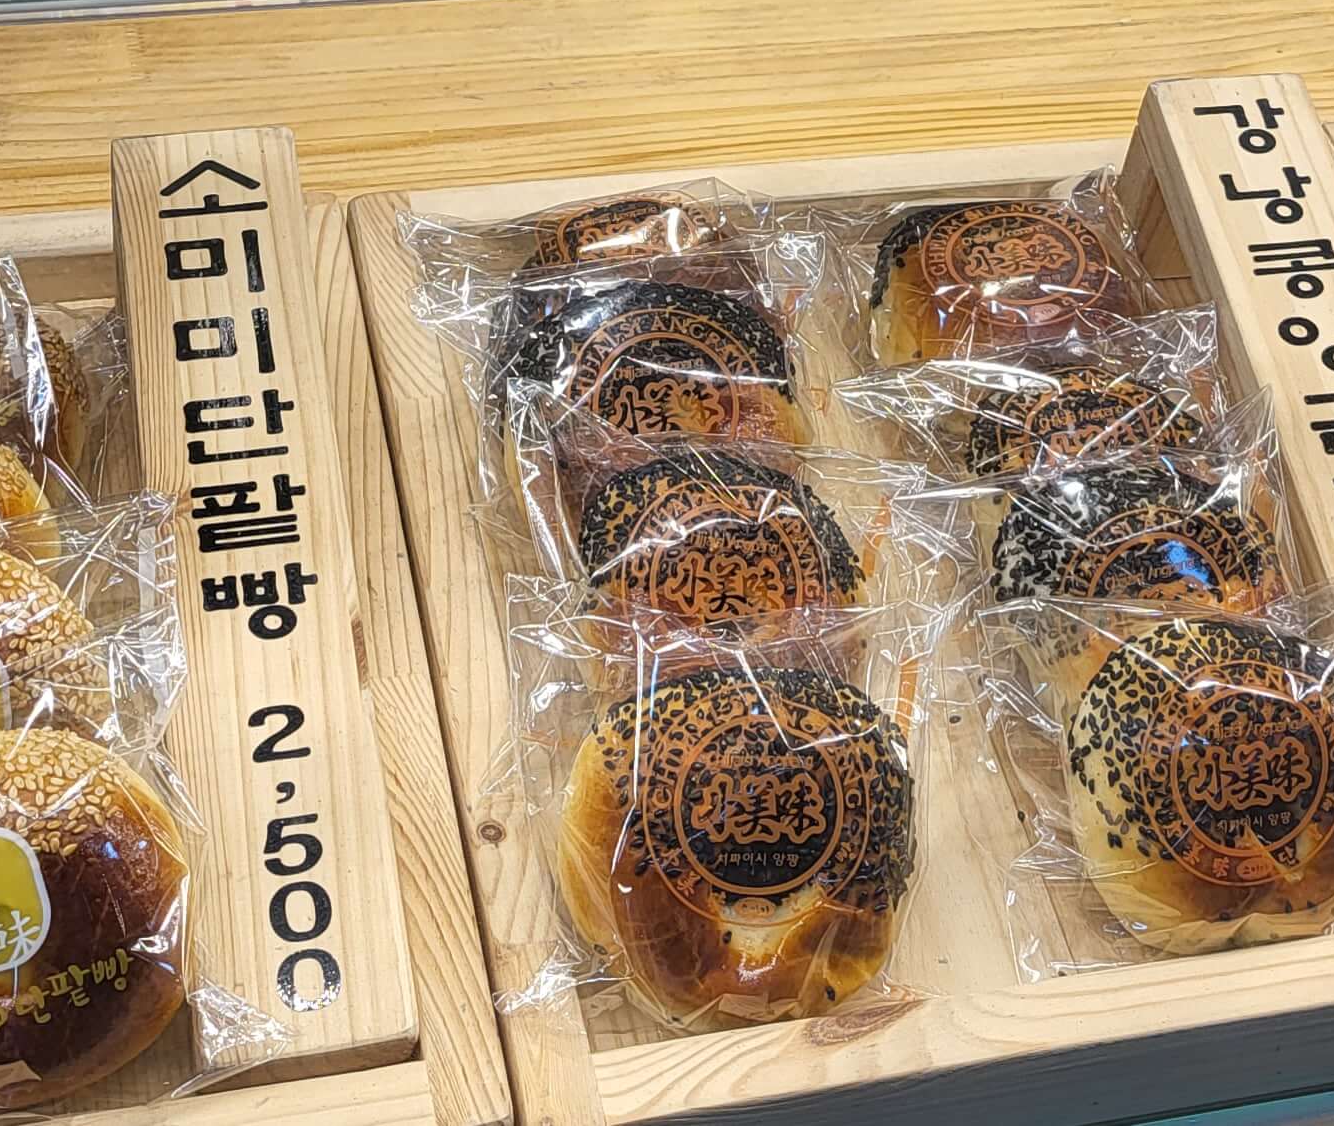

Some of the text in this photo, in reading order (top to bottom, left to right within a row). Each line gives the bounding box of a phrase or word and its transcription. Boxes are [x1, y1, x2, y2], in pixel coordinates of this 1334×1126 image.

[159, 160, 342, 1012] 소미미단팥빵 2,500
[692, 774, 827, 844] 小美味
[1189, 738, 1313, 809] 小美味
[16, 947, 134, 1024] 단팥빵
